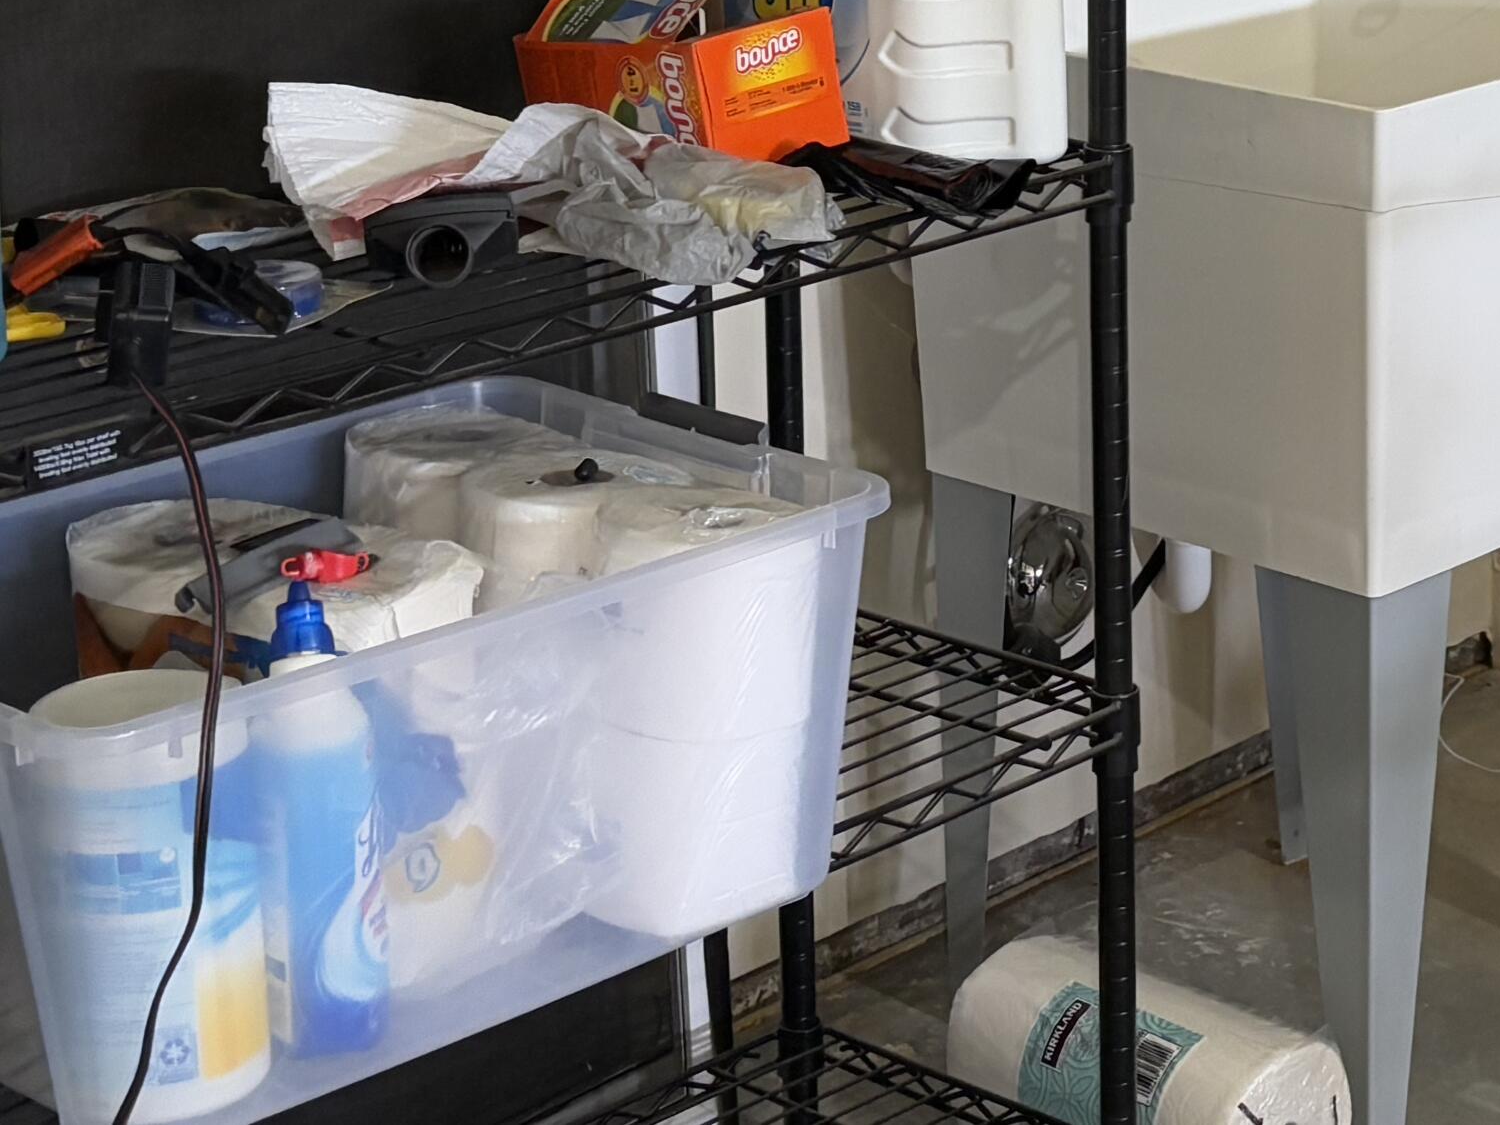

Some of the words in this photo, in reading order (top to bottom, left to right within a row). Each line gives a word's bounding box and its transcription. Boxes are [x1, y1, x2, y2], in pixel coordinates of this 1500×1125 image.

[736, 28, 799, 72] bounce
[661, 53, 698, 145] bounc
[1044, 1002, 1082, 1061] KIRKLAND
